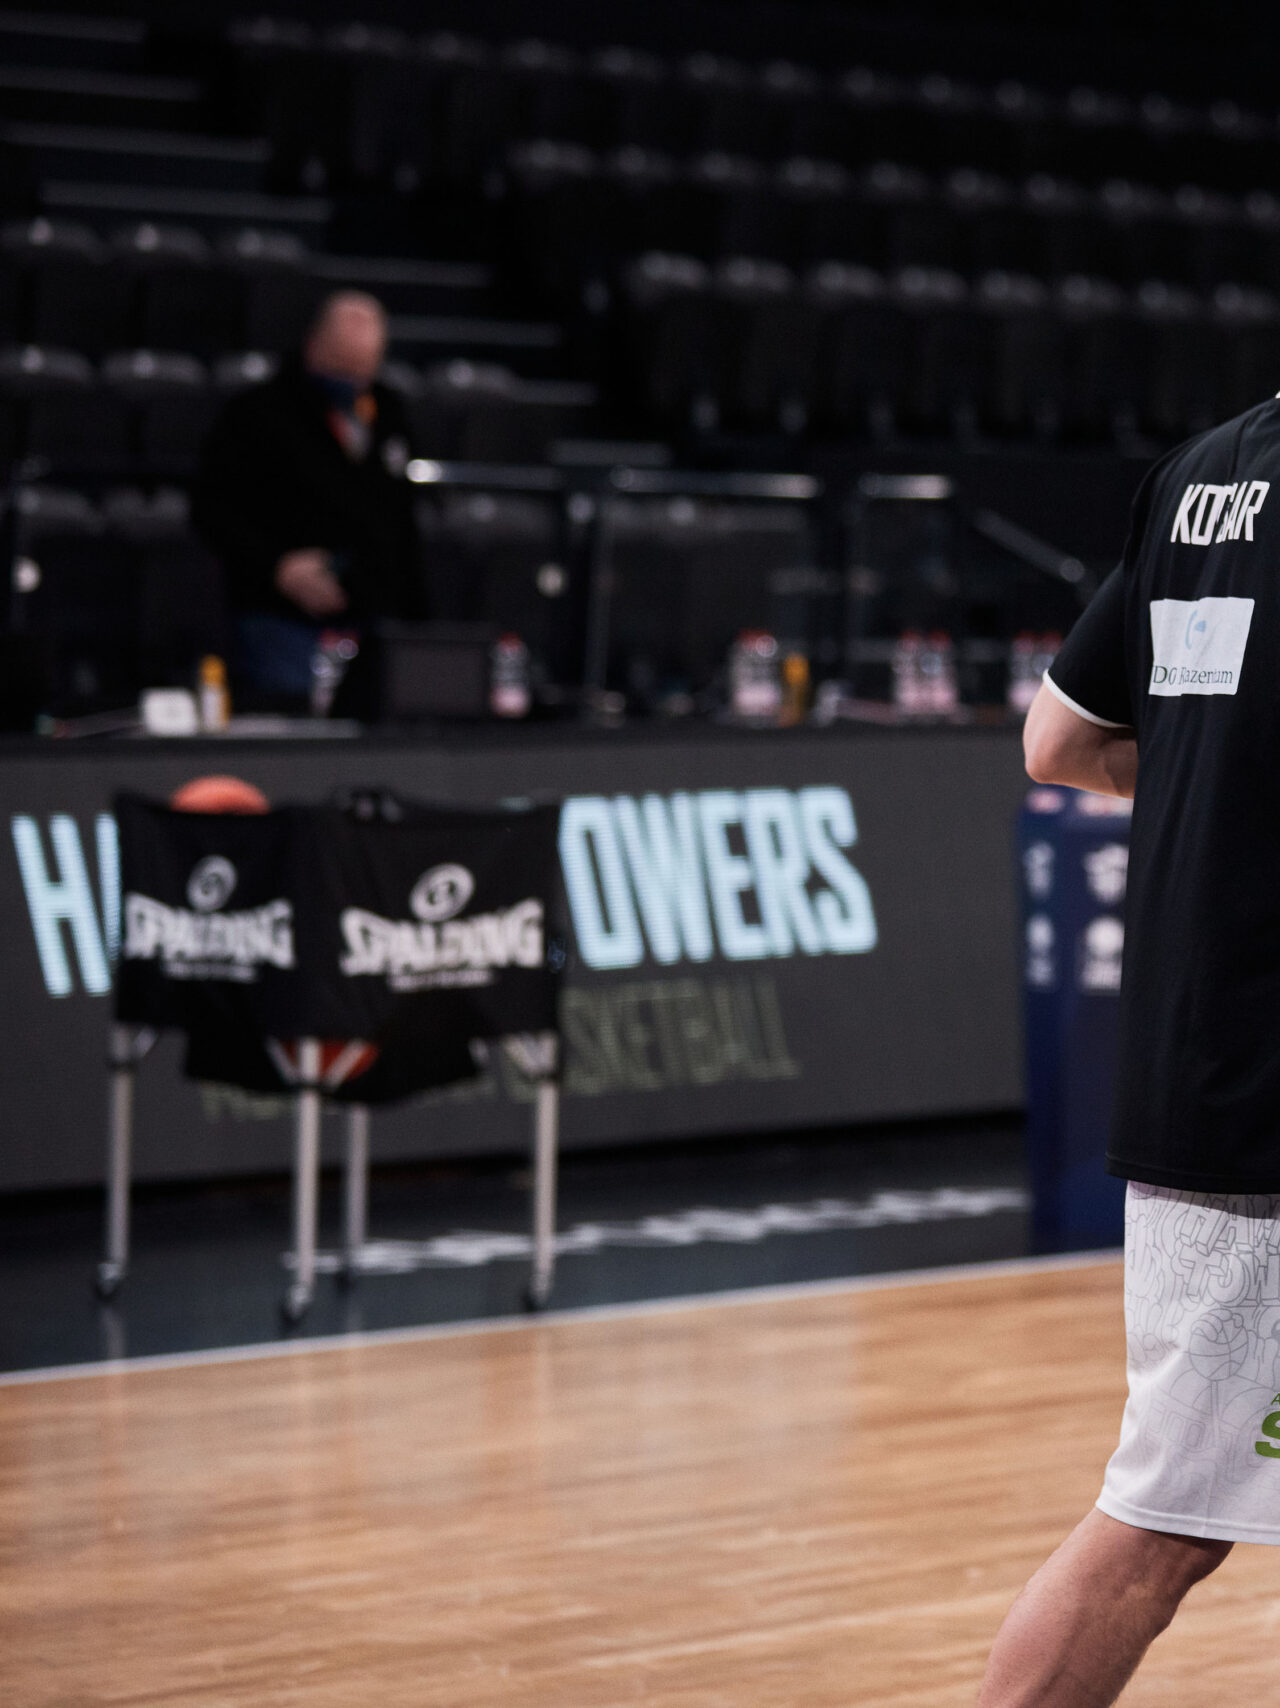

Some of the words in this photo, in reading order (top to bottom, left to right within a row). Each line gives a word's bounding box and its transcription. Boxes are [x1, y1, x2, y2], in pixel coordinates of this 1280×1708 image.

[12, 814, 118, 997] H
[559, 785, 879, 972] OWERS
[340, 896, 546, 977] SPALDING
